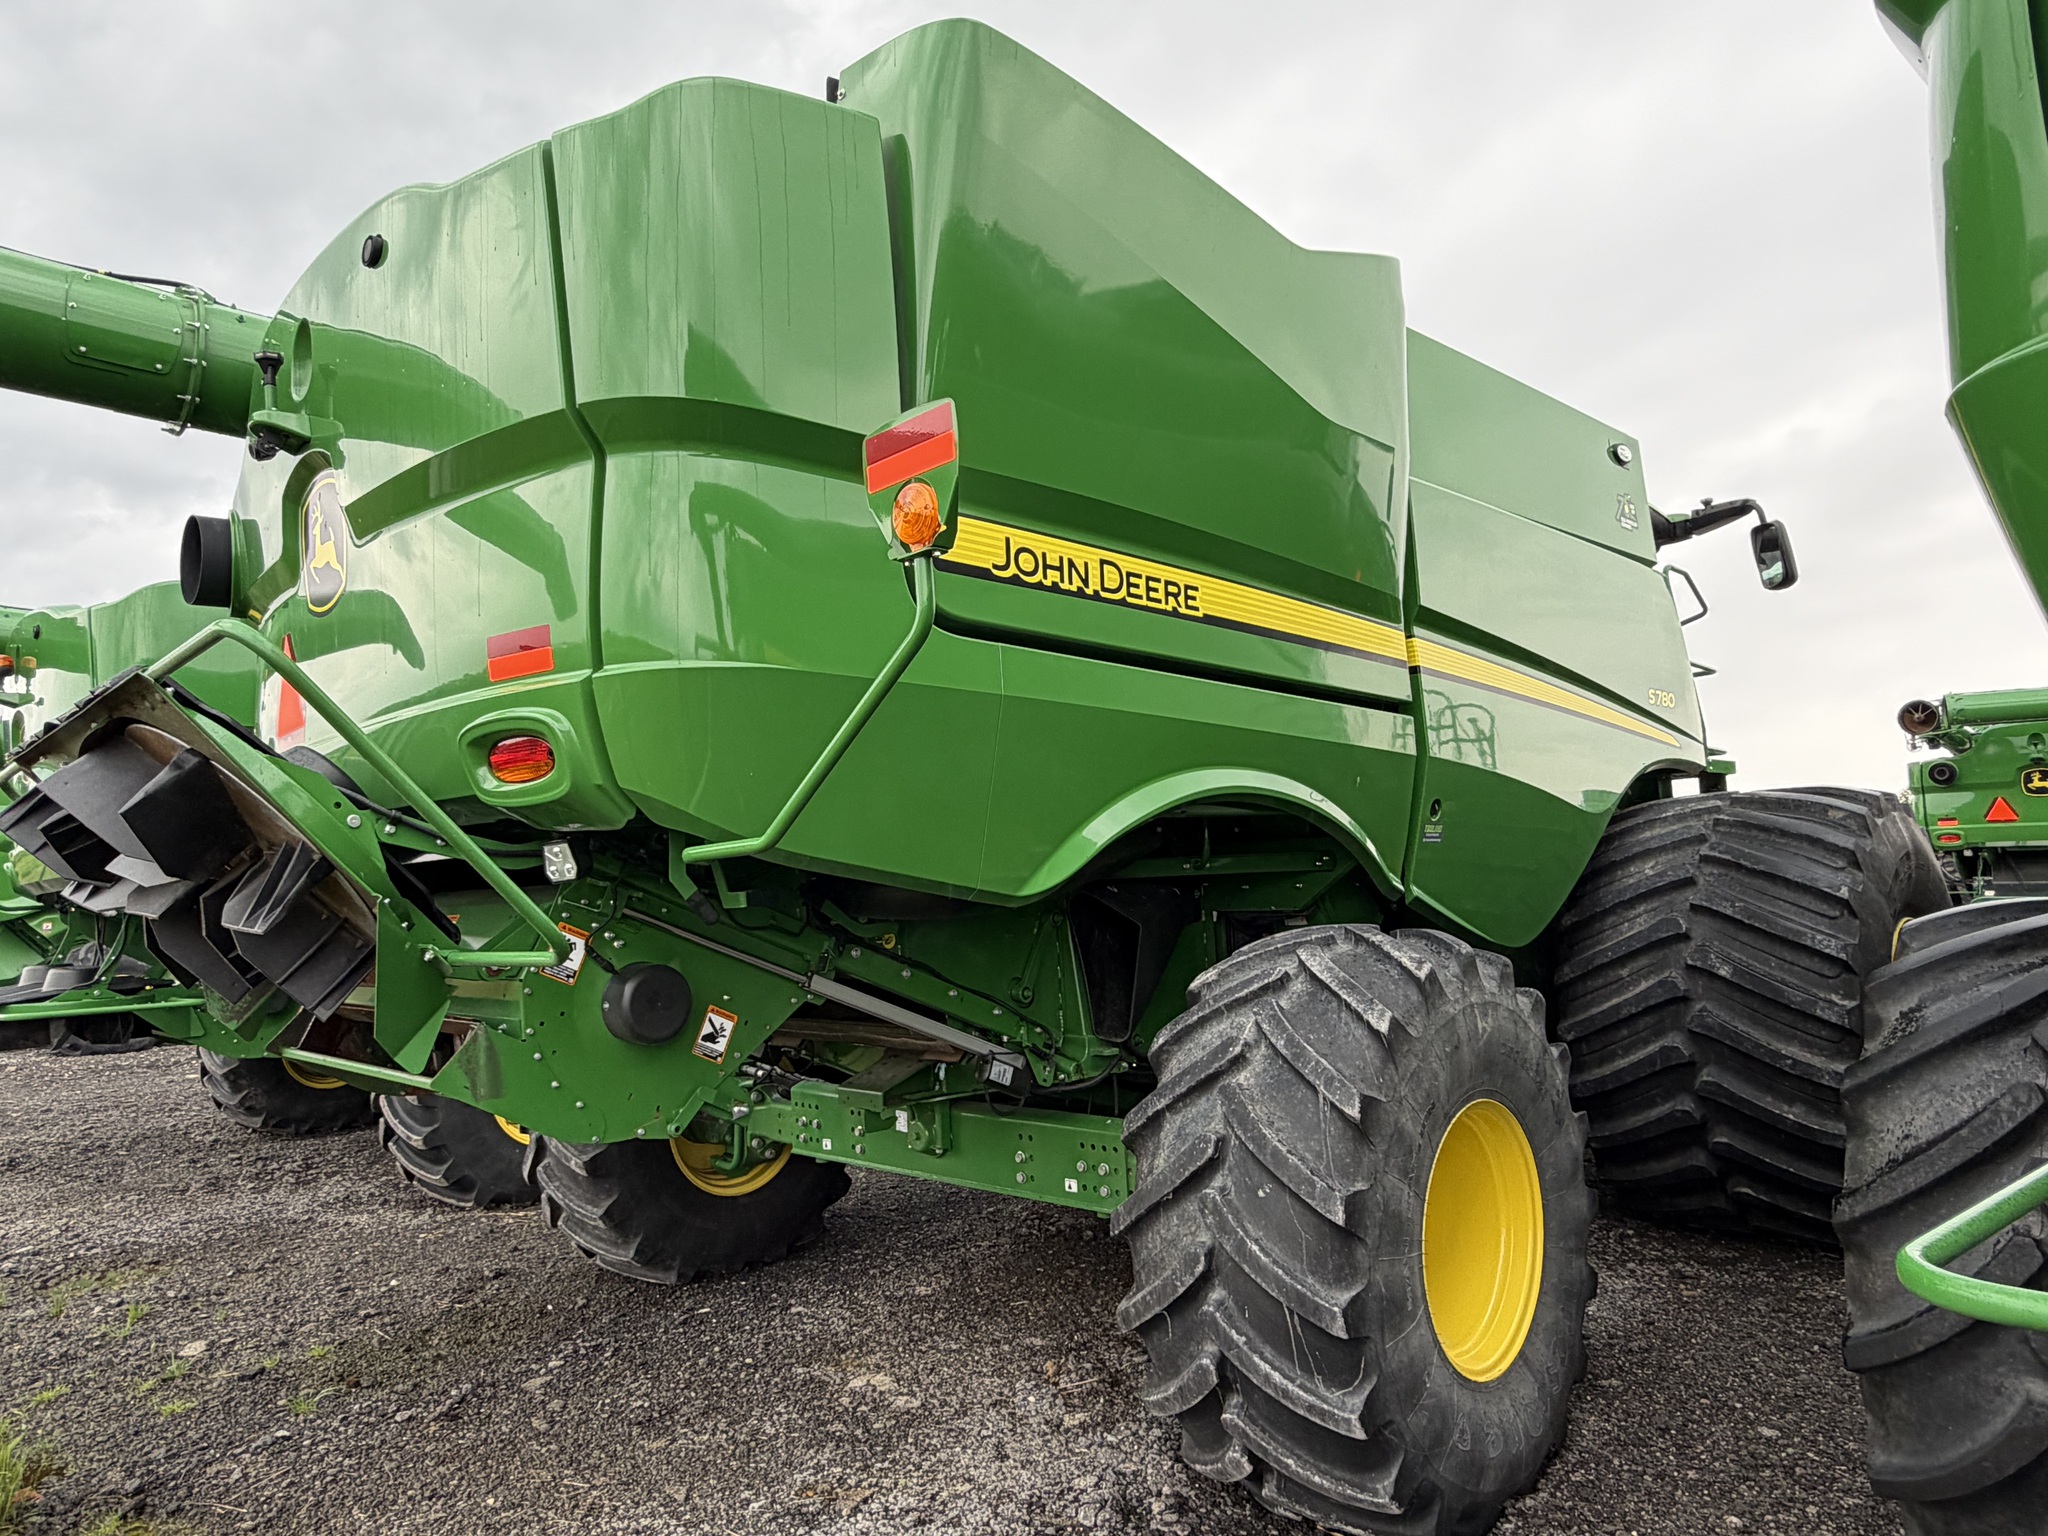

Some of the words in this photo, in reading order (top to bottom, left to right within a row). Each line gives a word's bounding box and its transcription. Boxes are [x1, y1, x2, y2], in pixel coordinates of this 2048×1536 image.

[991, 535, 1090, 591] JOHN
[1098, 557, 1201, 613] DEERE
[1648, 688, 1676, 709] S780
